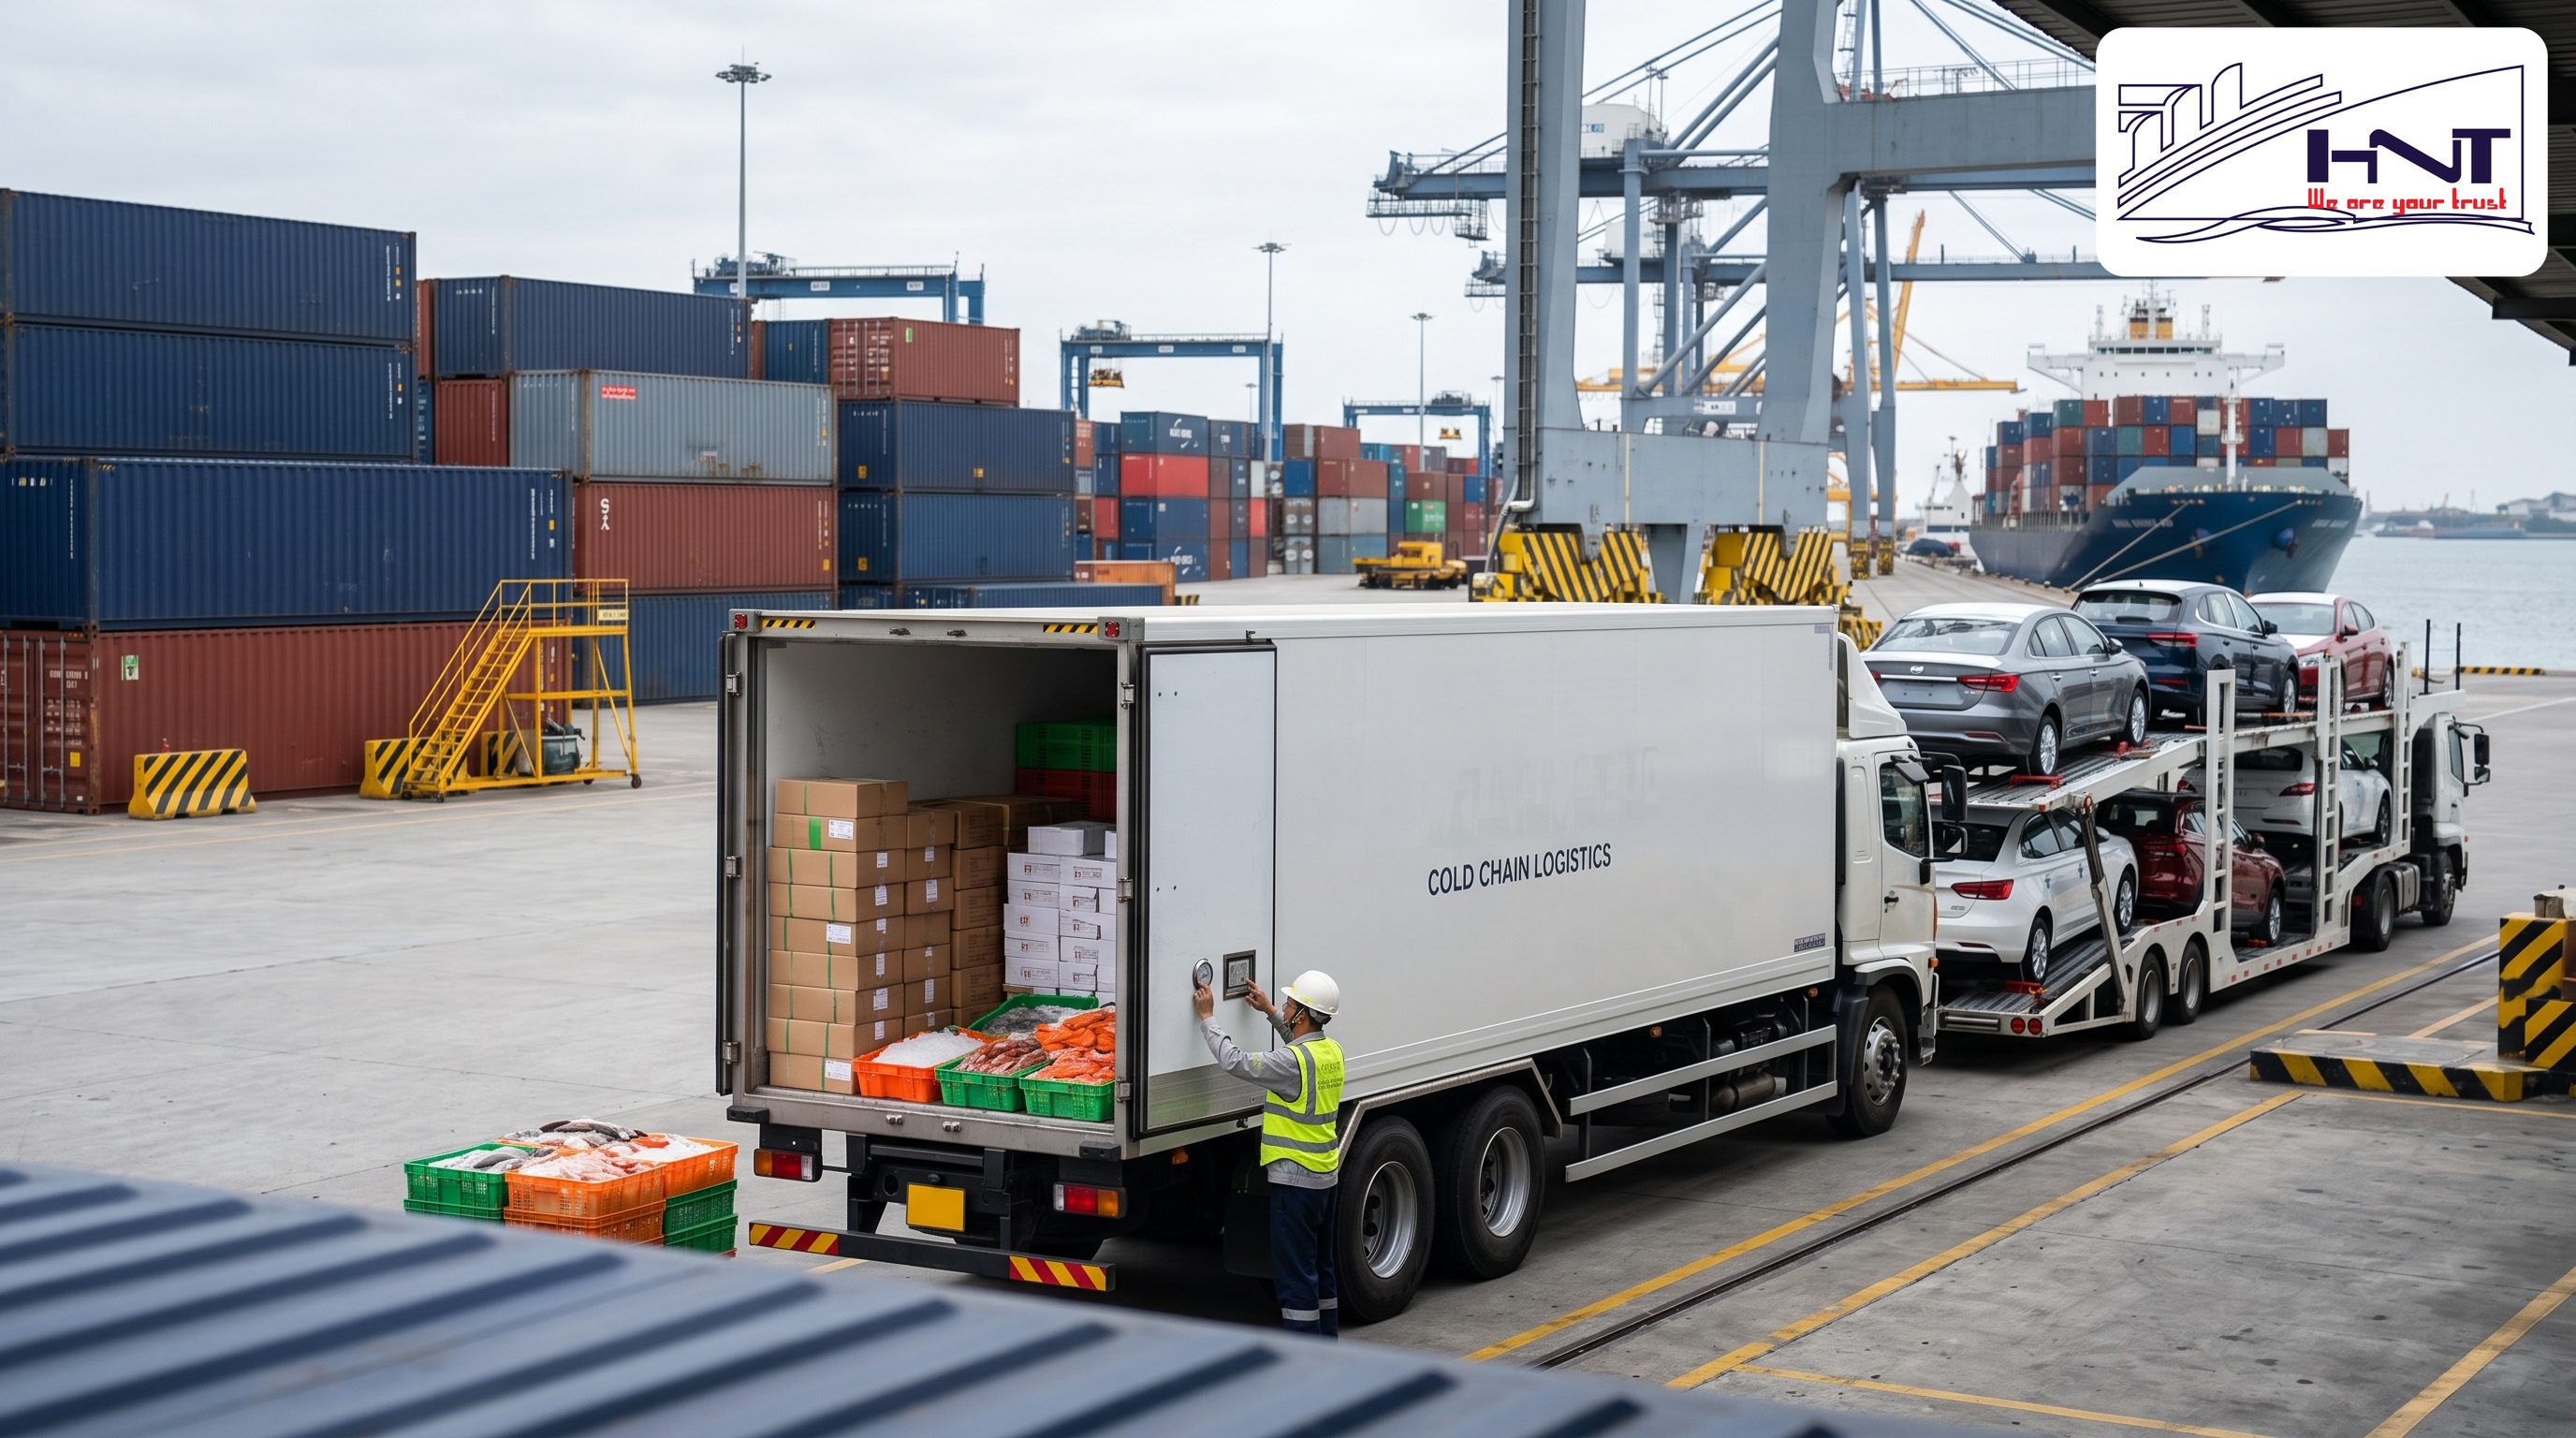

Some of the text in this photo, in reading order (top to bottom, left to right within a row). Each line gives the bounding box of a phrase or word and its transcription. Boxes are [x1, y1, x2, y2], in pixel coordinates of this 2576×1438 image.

[1427, 843, 1611, 896] COLD CHAIN LOGISTICS
